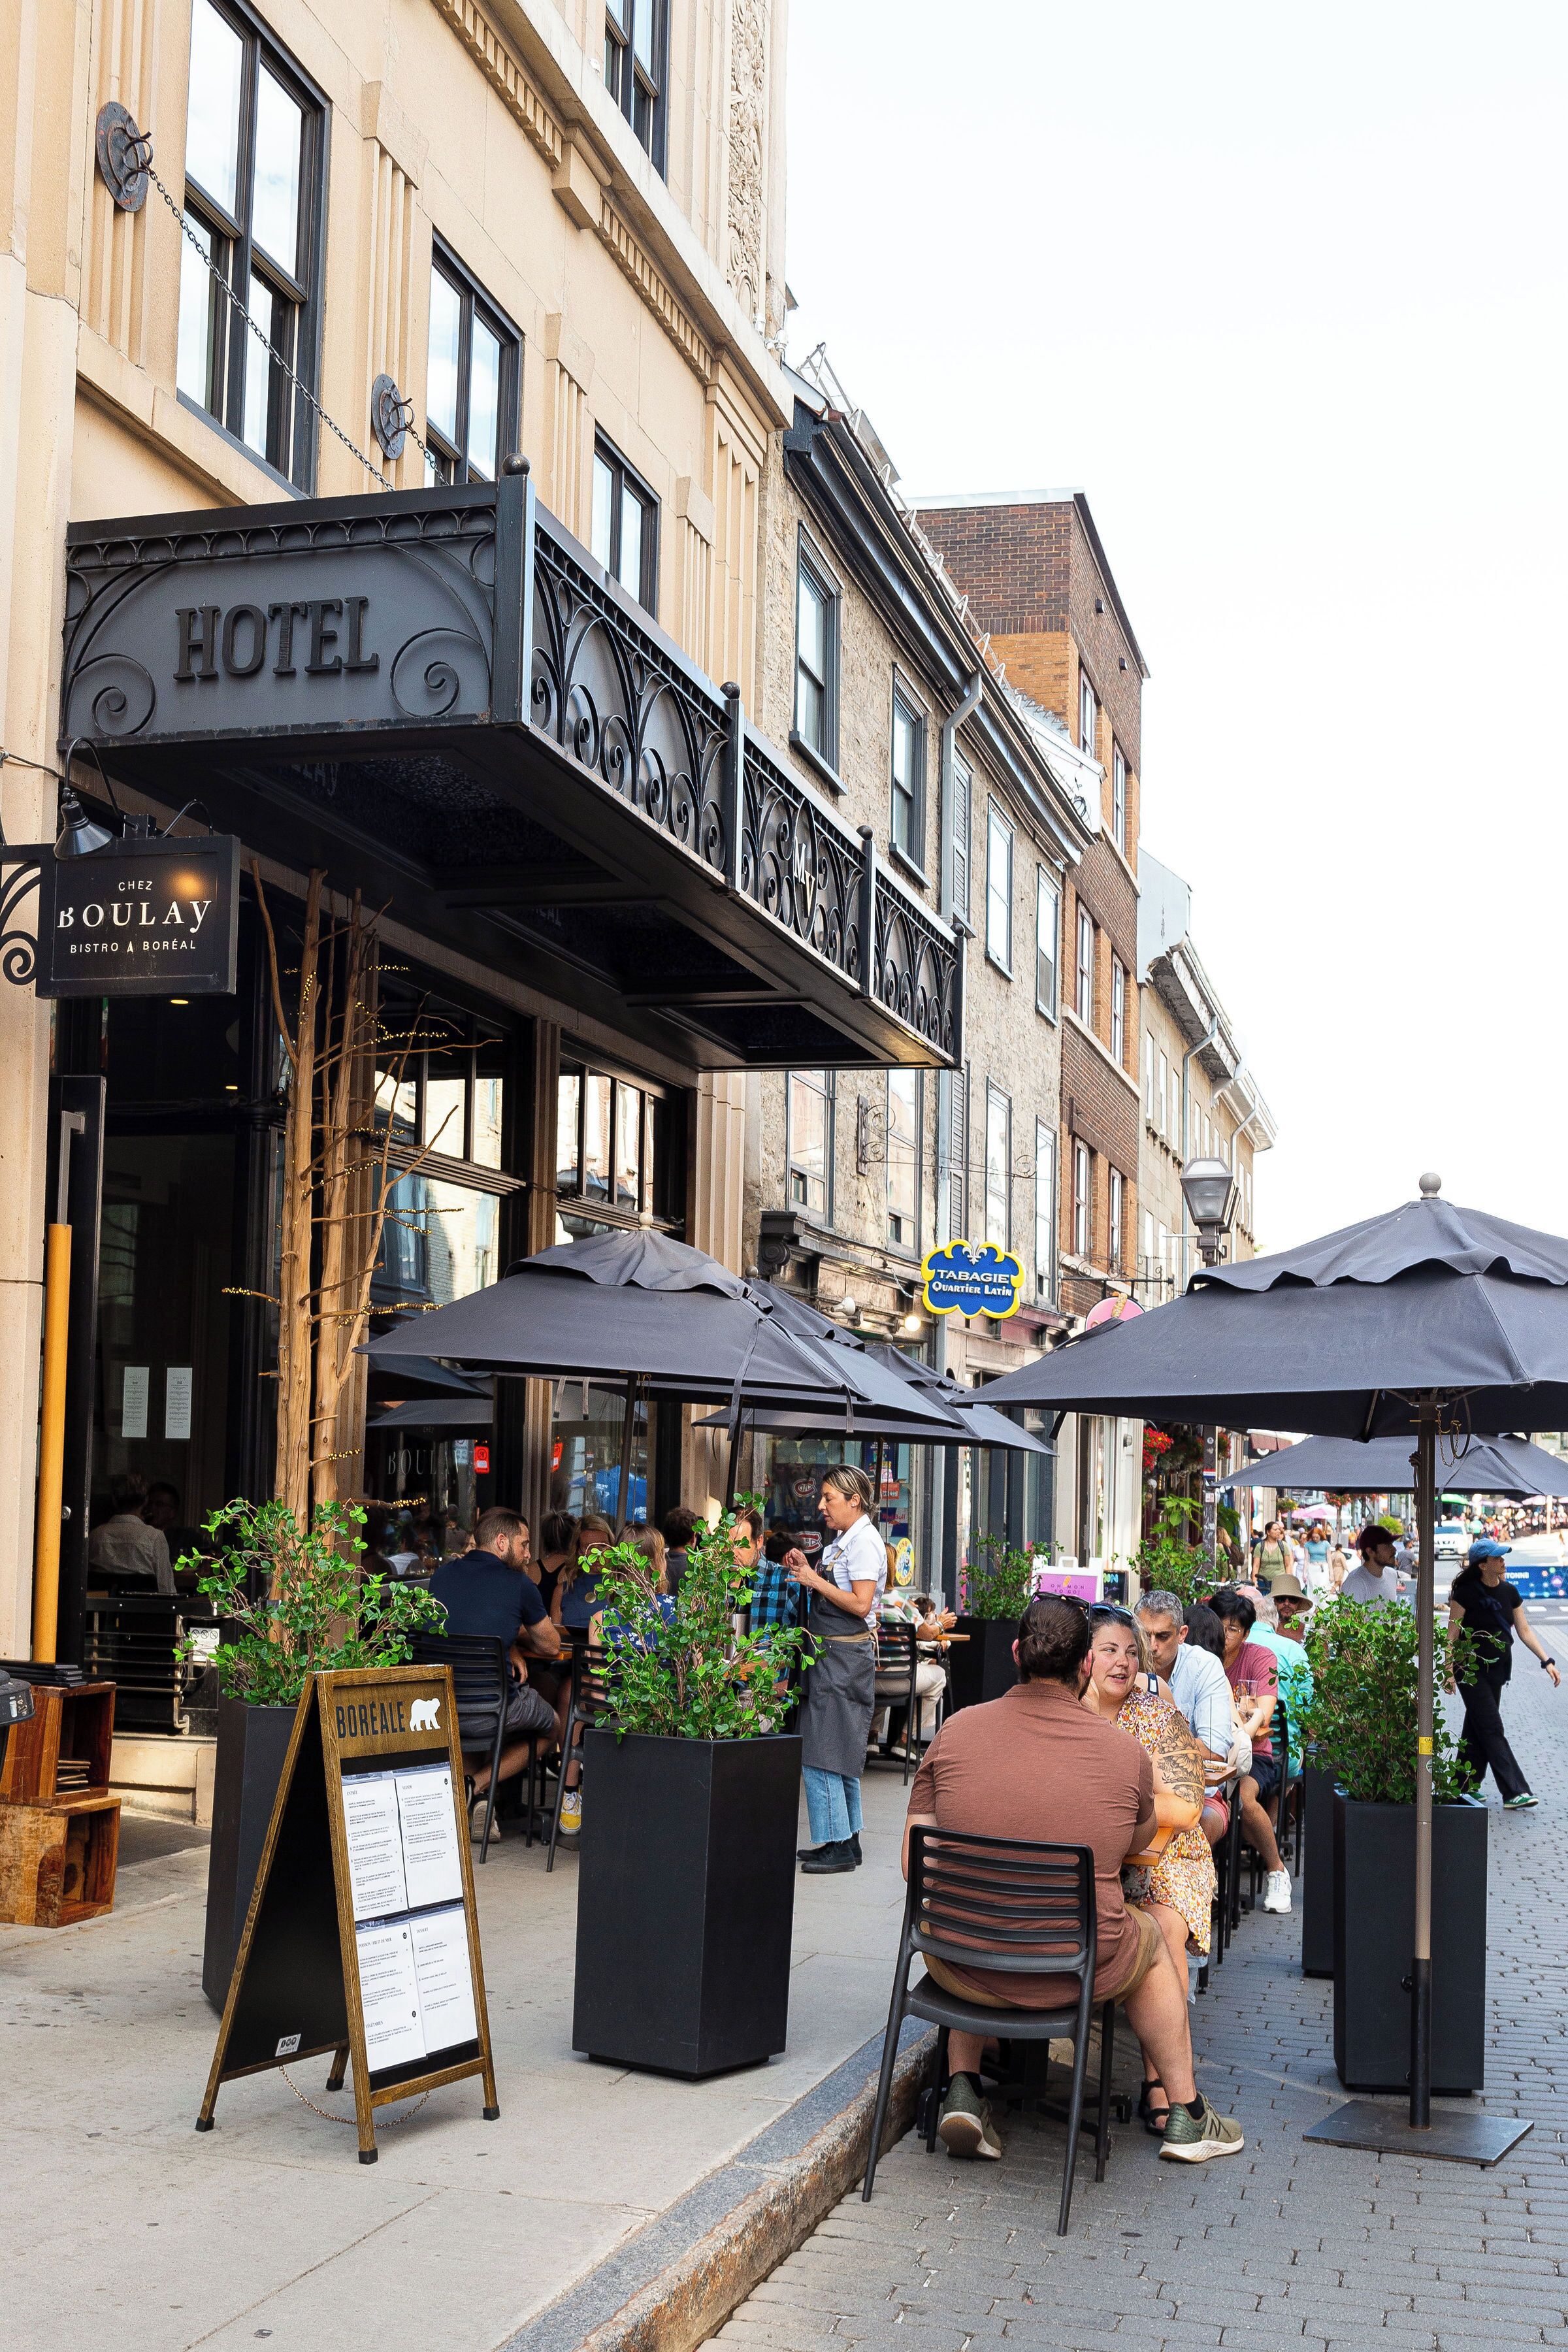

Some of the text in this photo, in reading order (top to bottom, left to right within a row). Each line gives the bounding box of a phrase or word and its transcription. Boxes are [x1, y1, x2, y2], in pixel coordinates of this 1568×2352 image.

[173, 596, 380, 681] HOTEL
[118, 881, 153, 891] CHEZ
[71, 943, 118, 953] BISTRO
[143, 938, 196, 951] BORÉAL
[937, 1269, 1009, 1284] TABAGIE
[336, 1701, 405, 1739] BORÉALE
